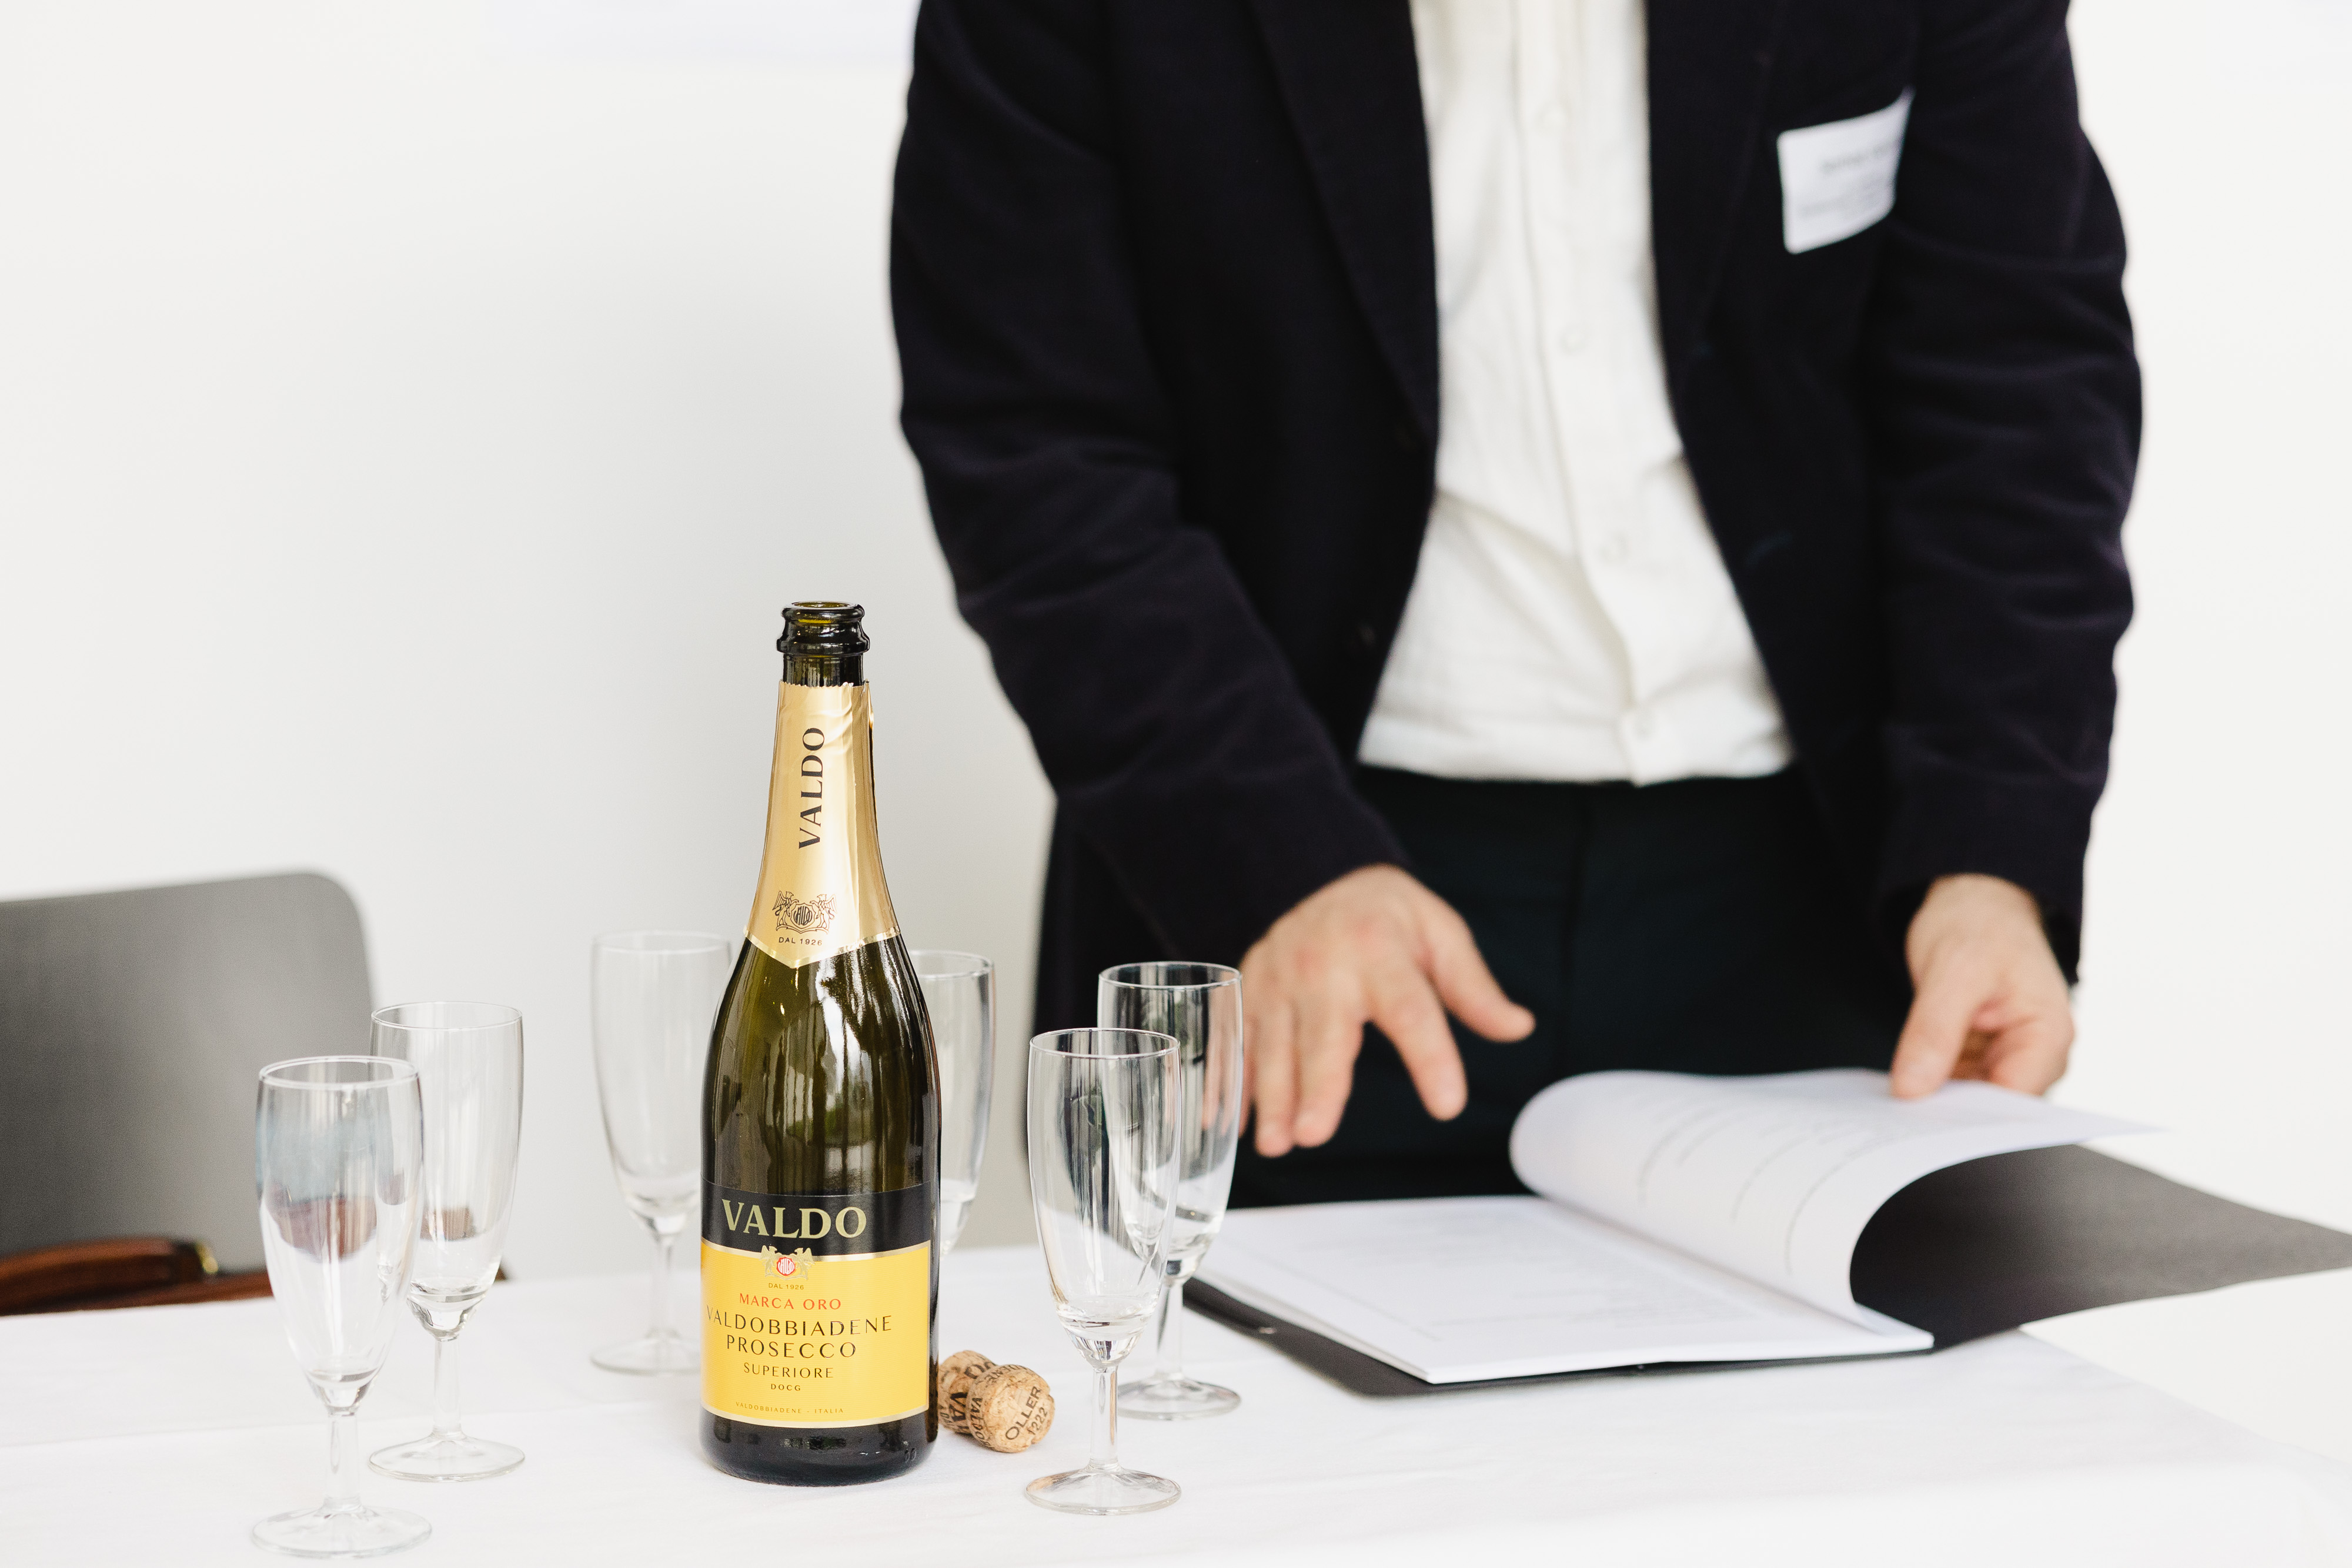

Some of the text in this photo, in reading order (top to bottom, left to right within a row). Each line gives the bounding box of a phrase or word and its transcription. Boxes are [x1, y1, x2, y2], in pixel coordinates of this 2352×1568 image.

[799, 727, 825, 849] VALDO
[721, 1198, 867, 1239] VALDO
[739, 1292, 841, 1310] MARCA ORO
[706, 1304, 892, 1336] VALDOBBIADENE
[727, 1334, 856, 1359] PROSECCO
[743, 1362, 834, 1379] SUPERIORE
[771, 1383, 801, 1392] DOCG
[736, 1401, 802, 1414] VALDOBBIADENE
[1005, 1386, 1042, 1440] OLLER
[1026, 1407, 1048, 1435] 1222
